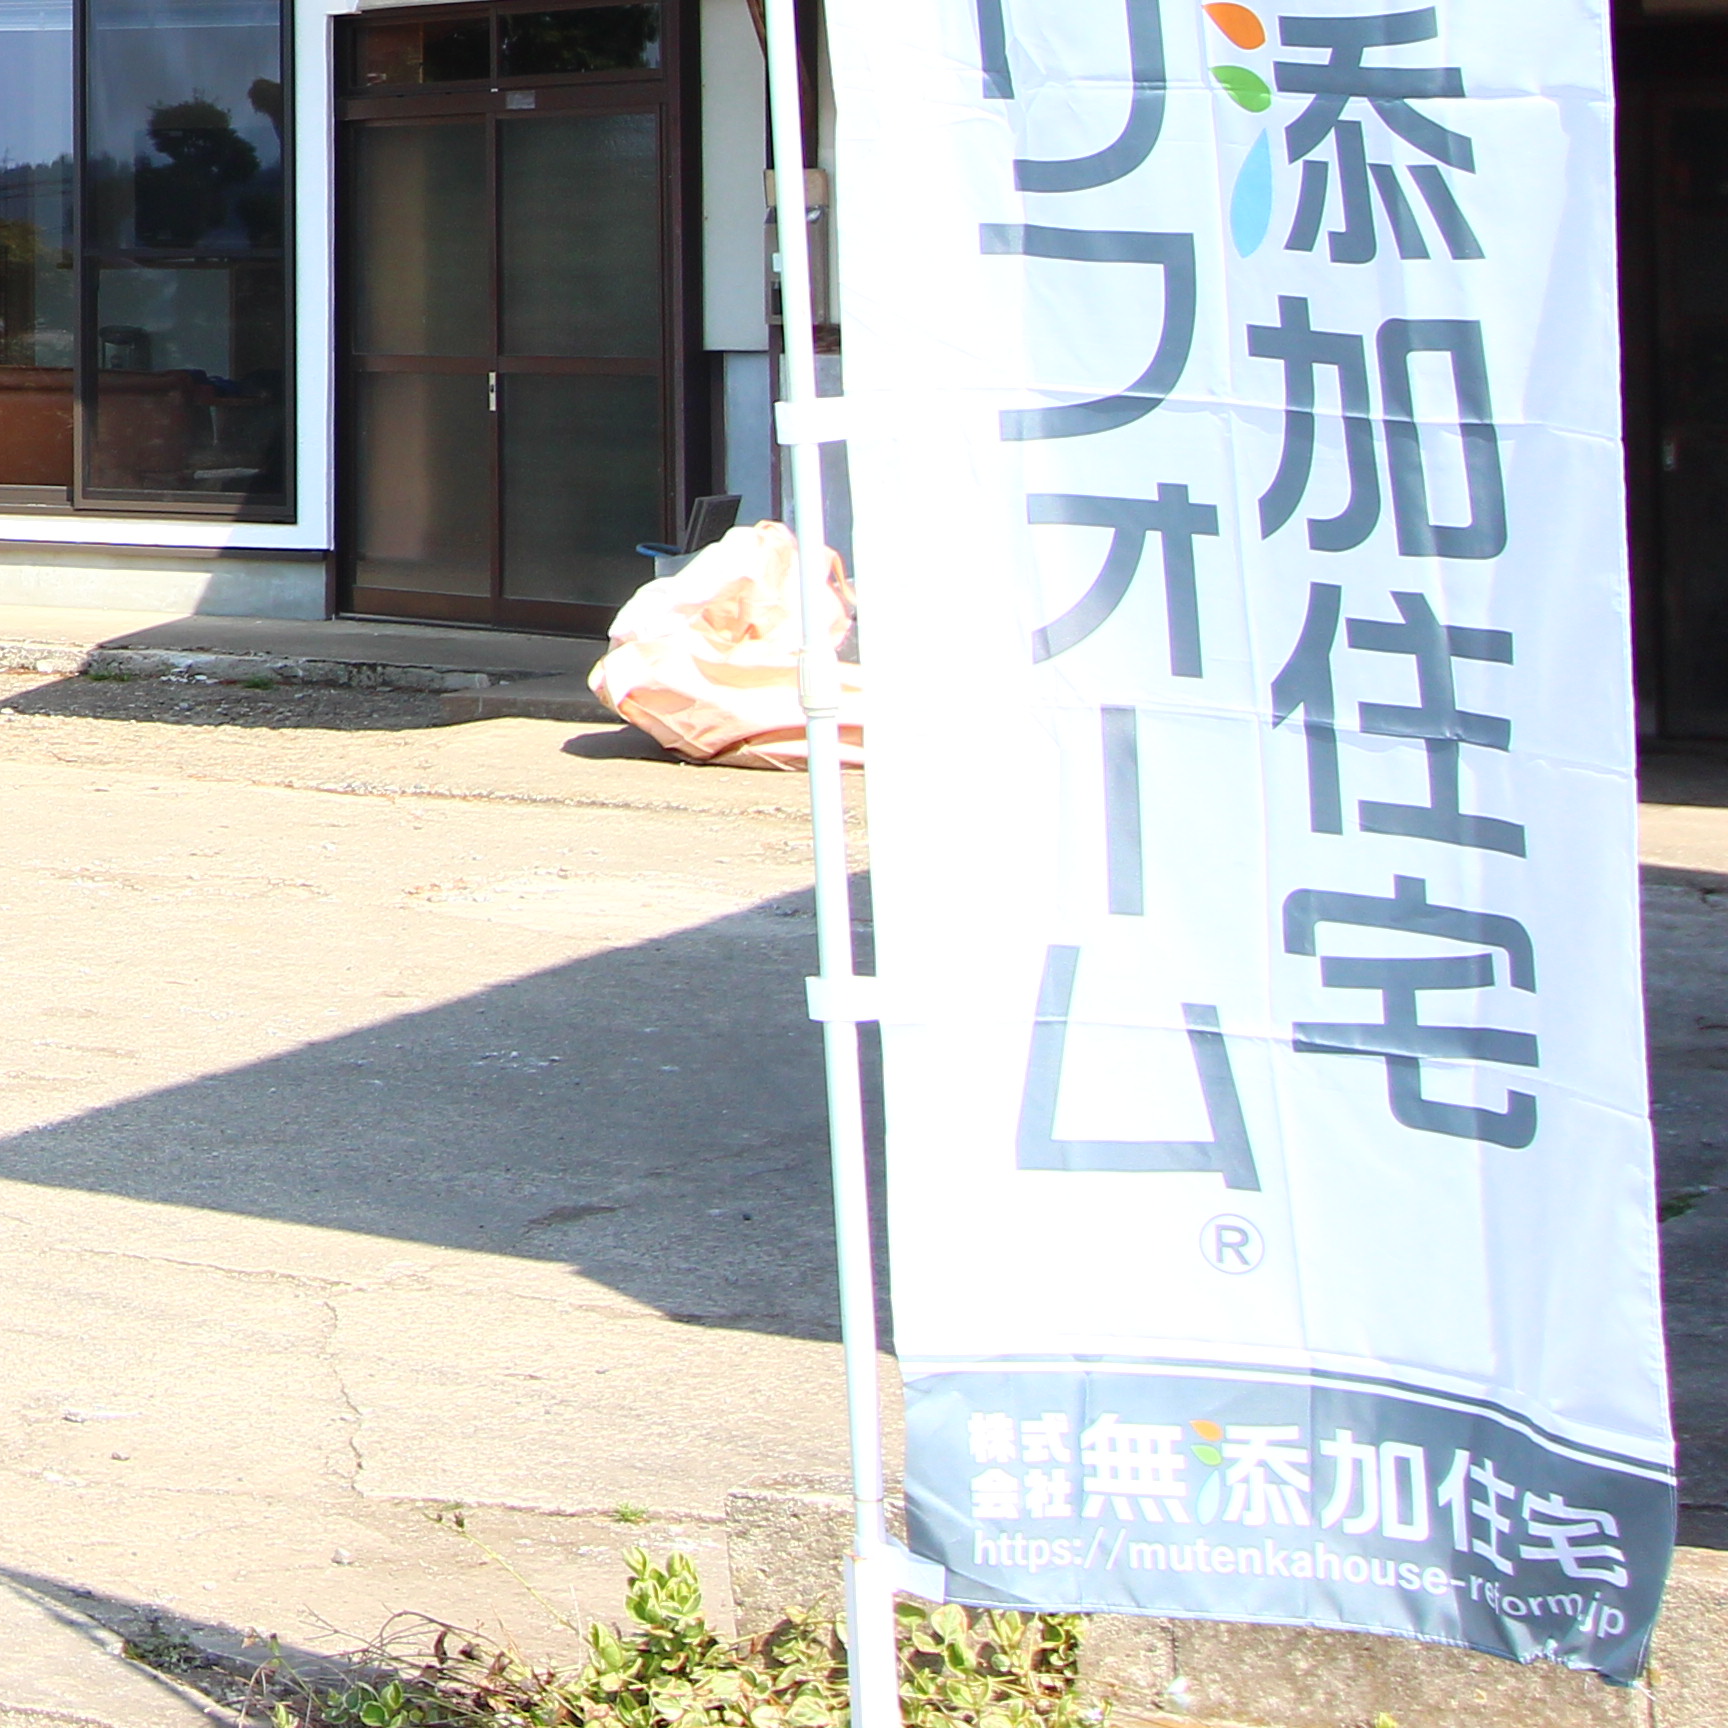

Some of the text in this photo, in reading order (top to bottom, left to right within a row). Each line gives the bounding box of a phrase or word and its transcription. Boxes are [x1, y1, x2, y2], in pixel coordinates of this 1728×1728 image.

[967, 1411, 1073, 1464] 株式
[970, 1467, 1074, 1520] 会社
[1079, 1412, 1629, 1589] 無添加住宅
